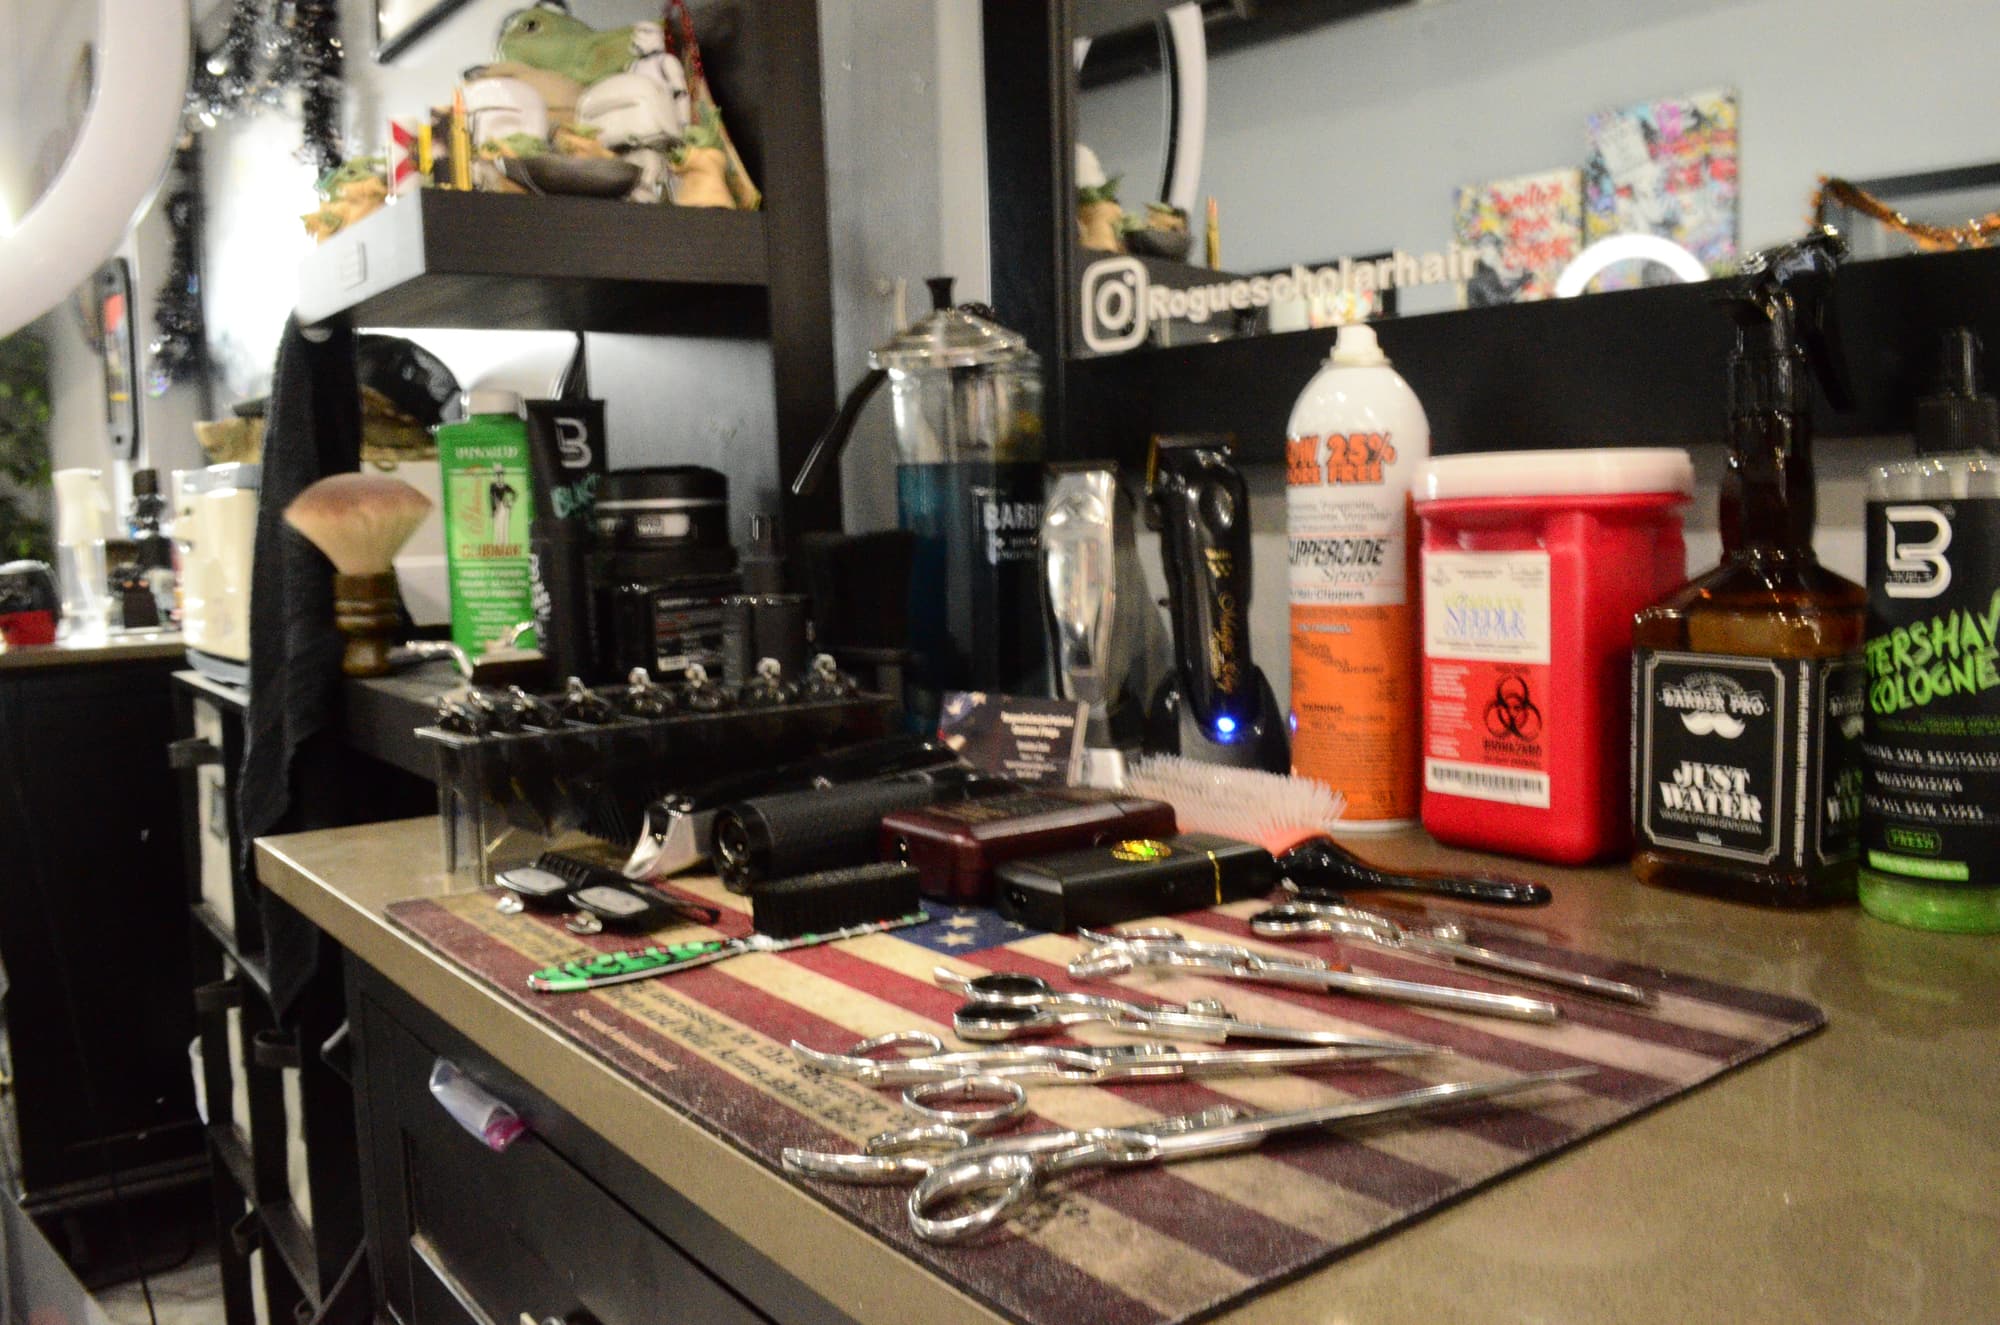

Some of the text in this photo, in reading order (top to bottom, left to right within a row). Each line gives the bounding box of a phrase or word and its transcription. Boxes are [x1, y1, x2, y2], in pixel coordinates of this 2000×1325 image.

[1148, 240, 1481, 323] Roguescholarhair
[1326, 431, 1398, 465] 25%
[1327, 463, 1384, 485] FREE
[983, 502, 1039, 531] BARB
[1287, 537, 1388, 567] LIPPERCIDE
[1865, 587, 2000, 678] TERSHAV
[1870, 648, 2000, 715] COLOGNE
[1663, 687, 1765, 716] BARBER PRO
[1896, 747, 1923, 764] AND
[1927, 750, 2000, 768] REVITALIZI
[1672, 760, 1751, 794] JUST
[1659, 781, 1763, 824] WATER
[1904, 799, 1937, 818] SKIN
[1942, 802, 1984, 820] TYPES
[1889, 828, 1935, 849] FRESH
